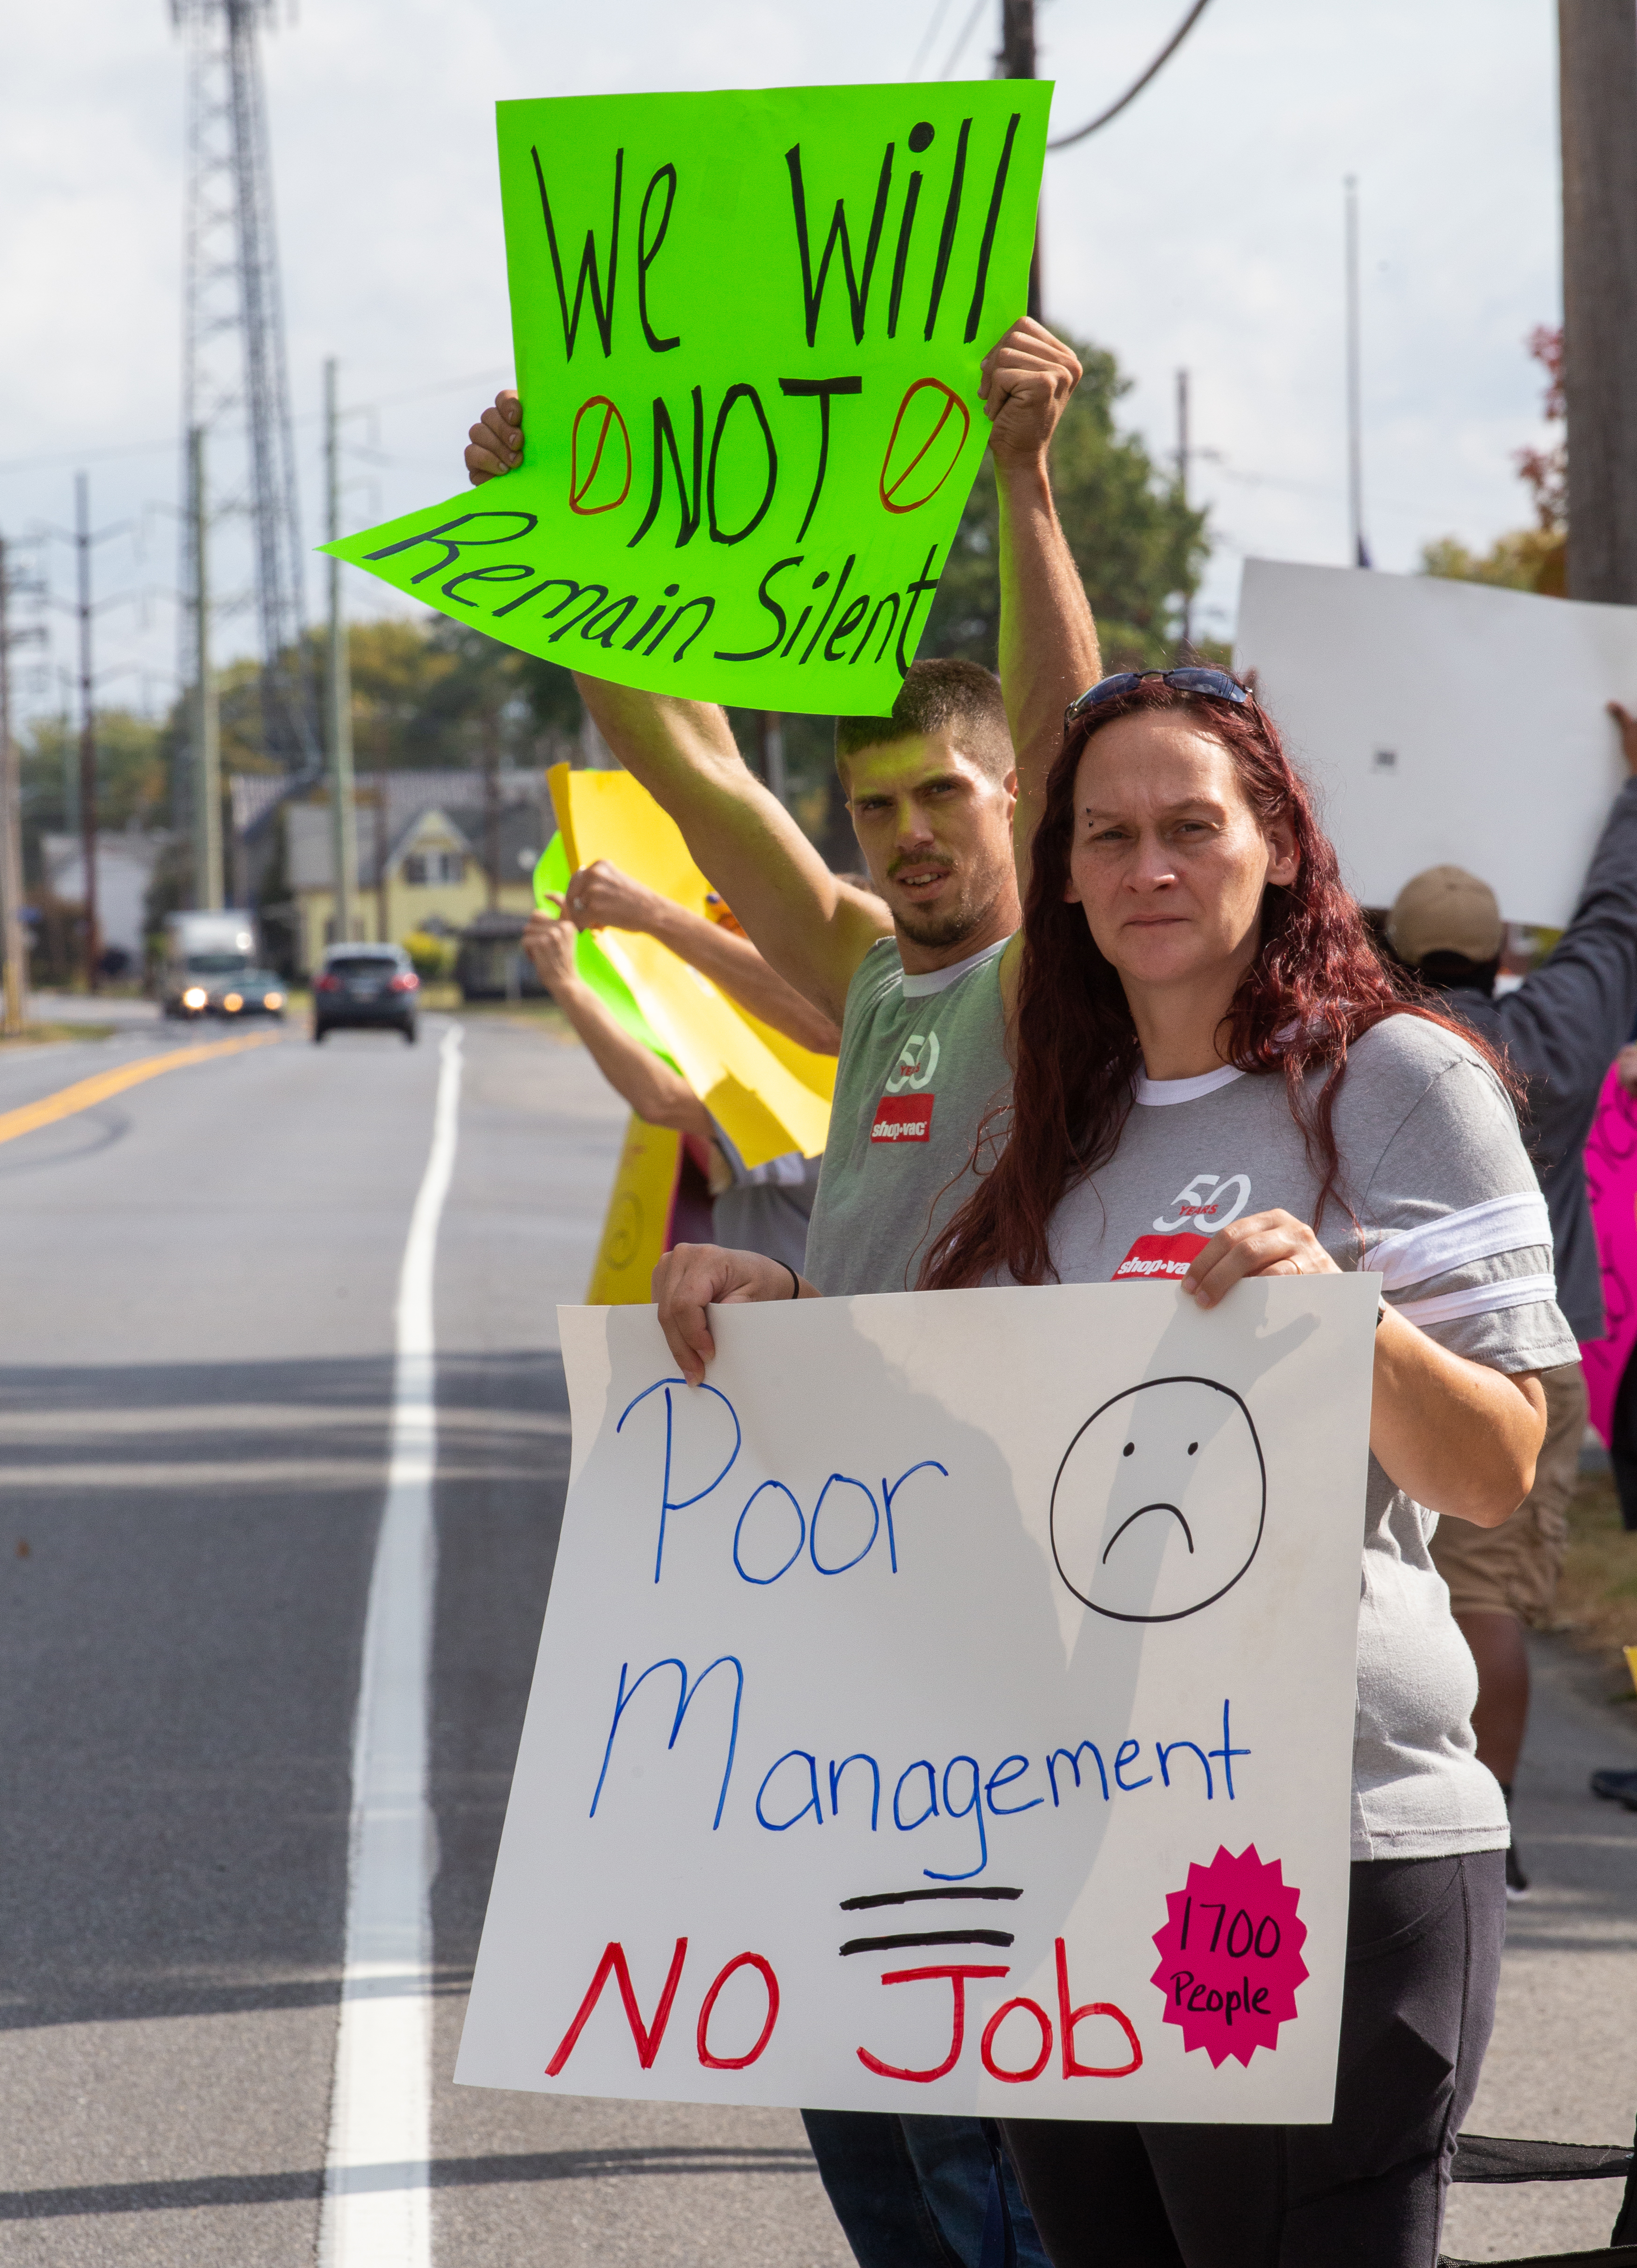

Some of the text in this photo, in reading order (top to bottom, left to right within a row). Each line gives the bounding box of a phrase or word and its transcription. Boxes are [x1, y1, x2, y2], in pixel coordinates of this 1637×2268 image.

[531, 113, 1021, 363] We Will
[627, 376, 863, 548] NOT
[362, 512, 939, 680] Remain Silent
[885, 1031, 940, 1093] 50
[900, 1062, 921, 1077] YES
[1152, 1174, 1251, 1233] 50
[1178, 1204, 1219, 1216] YEARS
[617, 1378, 948, 1585] Poor
[590, 1655, 1251, 1881] Management
[1180, 1896, 1281, 1958] 1700
[545, 1937, 1143, 2084] NO Job
[1170, 1971, 1271, 2026] People
